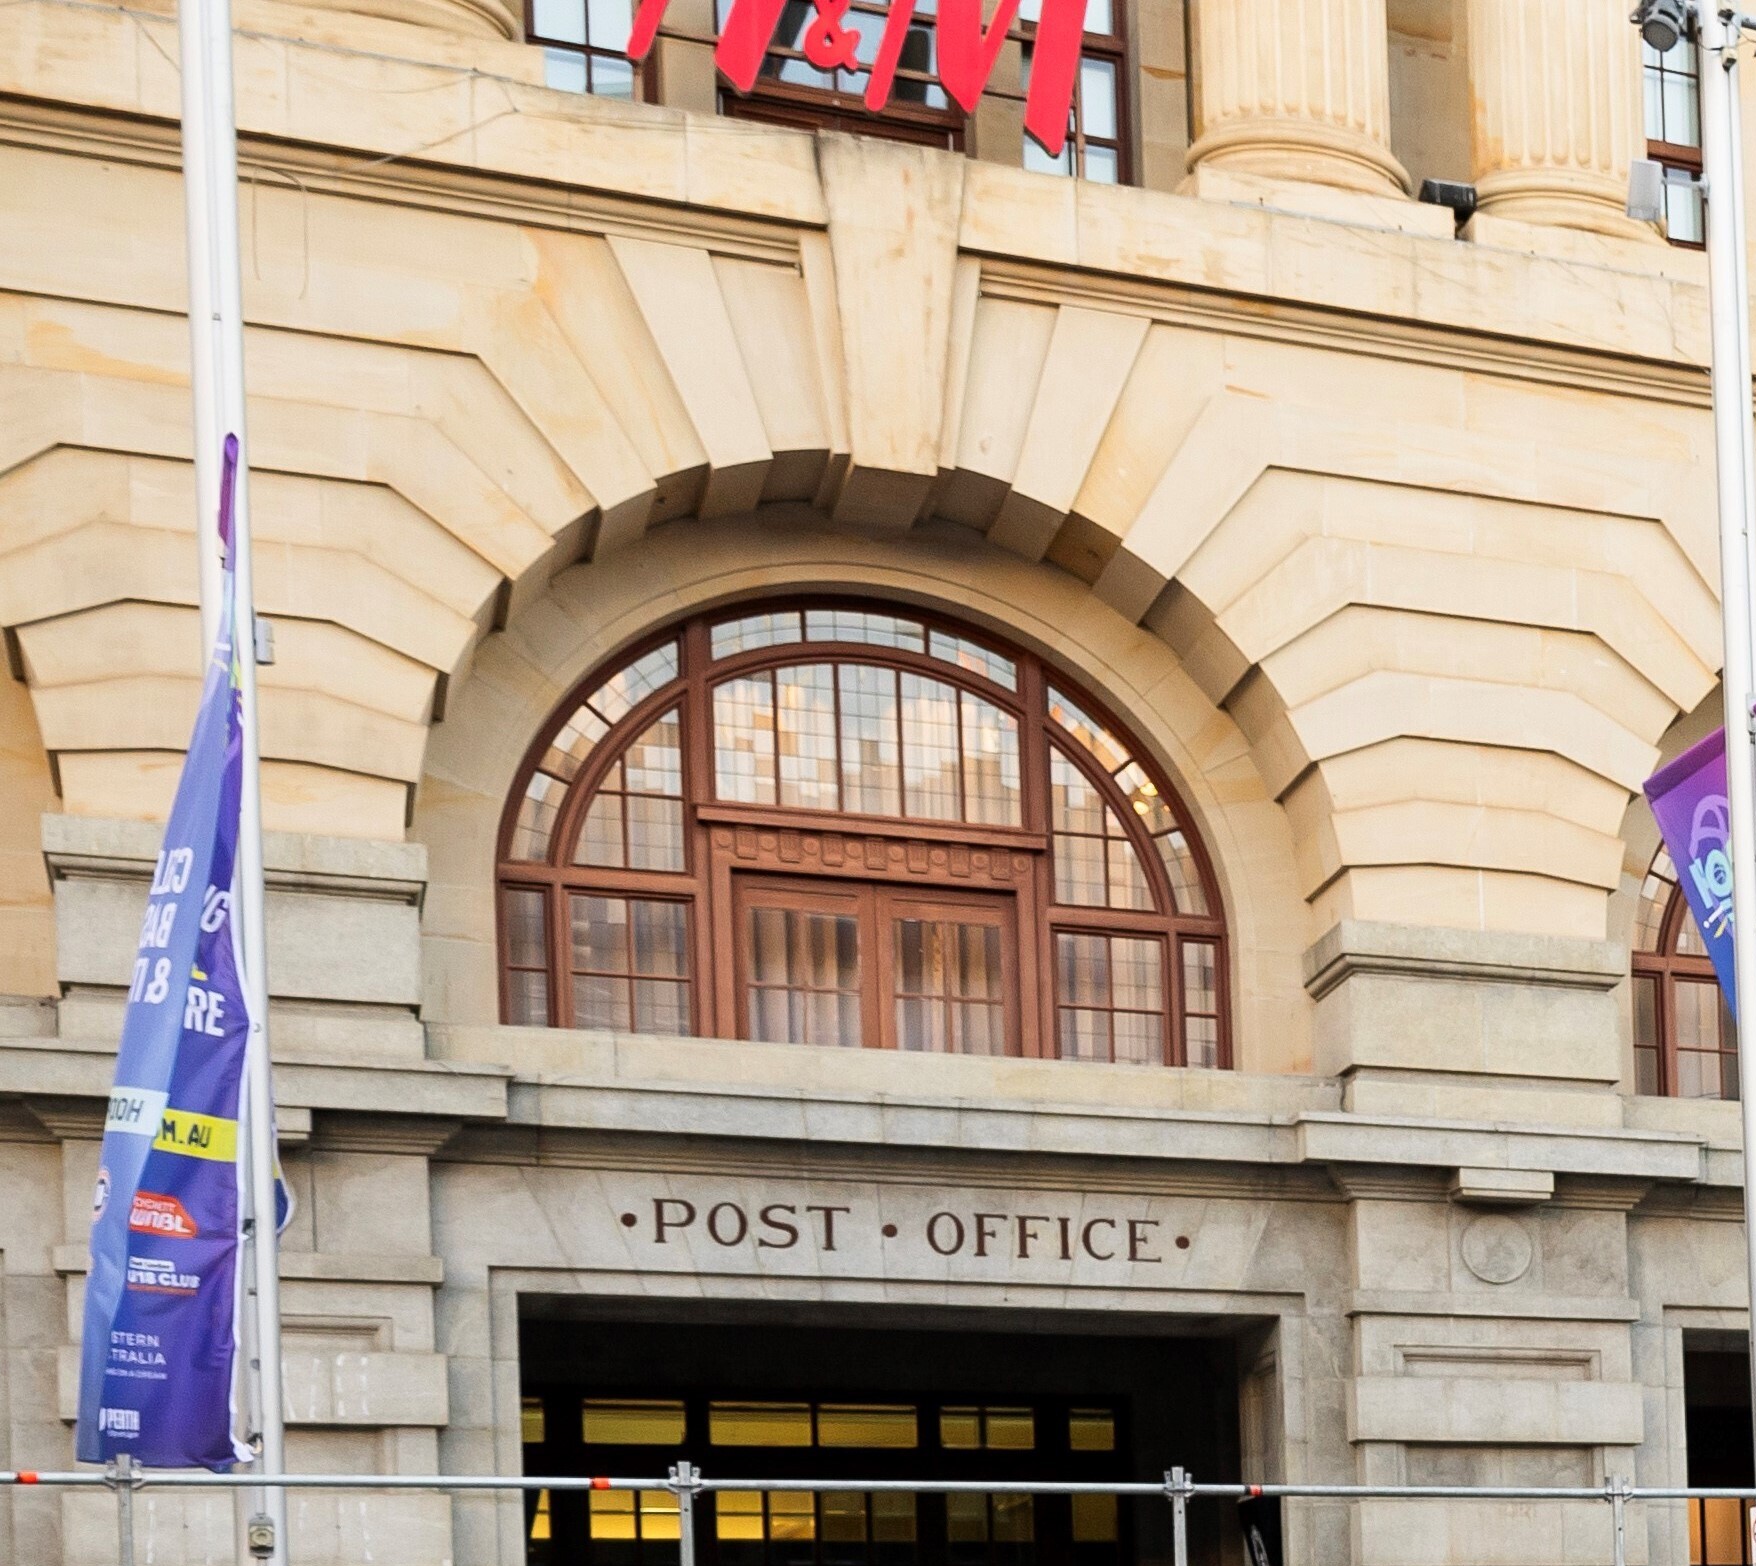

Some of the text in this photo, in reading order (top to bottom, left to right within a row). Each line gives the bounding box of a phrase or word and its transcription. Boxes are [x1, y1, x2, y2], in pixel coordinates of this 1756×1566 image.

[652, 1198, 1162, 1263] POST OFFICE
[111, 1331, 160, 1348] STERN
[110, 1349, 167, 1366] TRALIA
